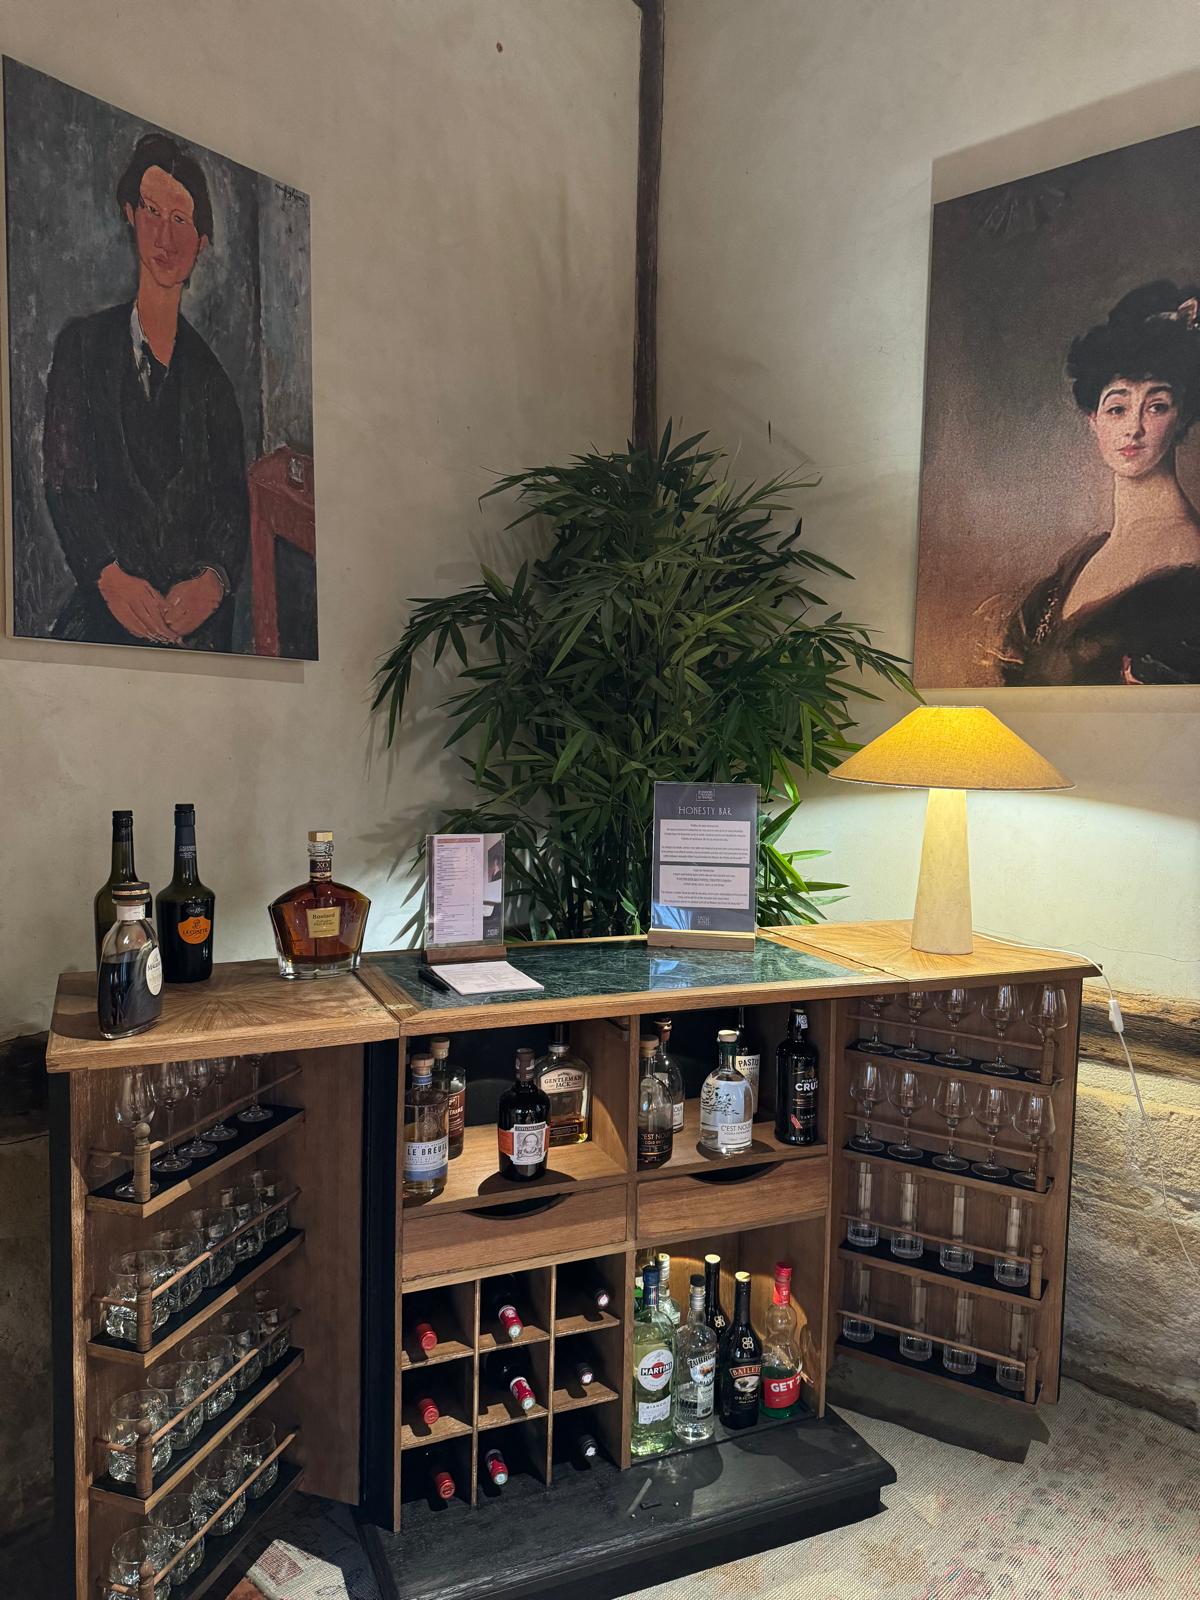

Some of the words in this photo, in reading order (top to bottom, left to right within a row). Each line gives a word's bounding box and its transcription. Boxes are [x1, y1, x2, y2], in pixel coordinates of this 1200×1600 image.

[678, 806, 715, 815] HONESTY
[718, 807, 732, 816] BAR
[544, 1074, 583, 1084] GENTLEMAN
[407, 1148, 417, 1156] LE
[641, 1362, 673, 1376] MARTINI
[770, 1379, 795, 1392] GET
